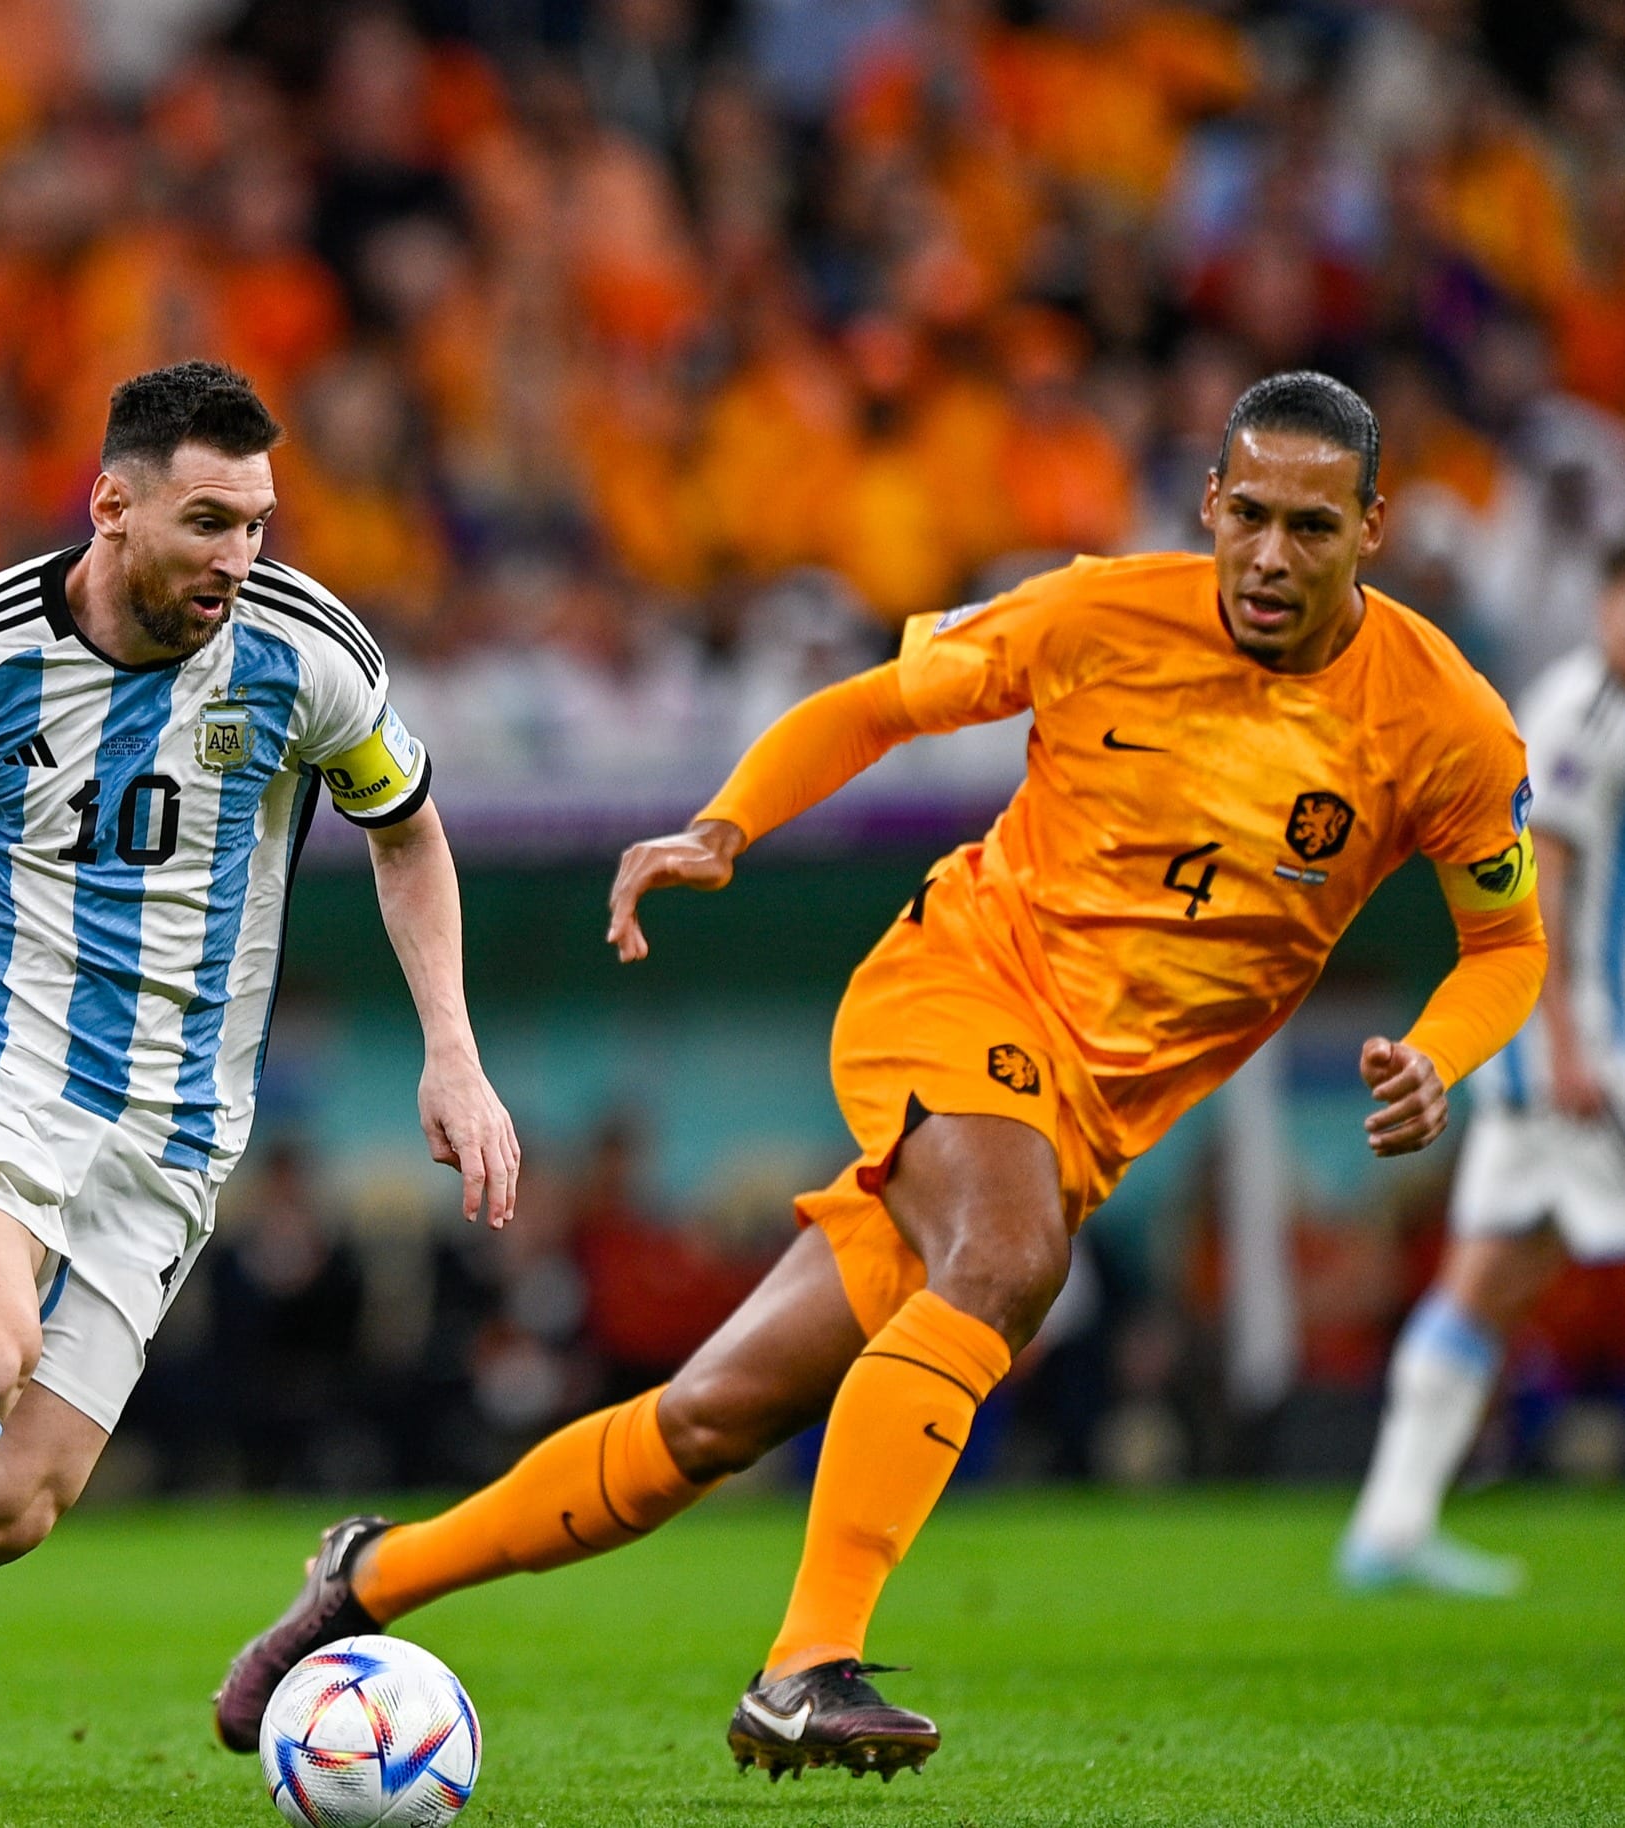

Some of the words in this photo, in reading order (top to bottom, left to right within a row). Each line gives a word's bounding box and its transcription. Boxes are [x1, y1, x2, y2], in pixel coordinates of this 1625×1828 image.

[208, 723, 241, 755] AFA
[57, 774, 181, 866] 10
[1163, 841, 1223, 921] 4
